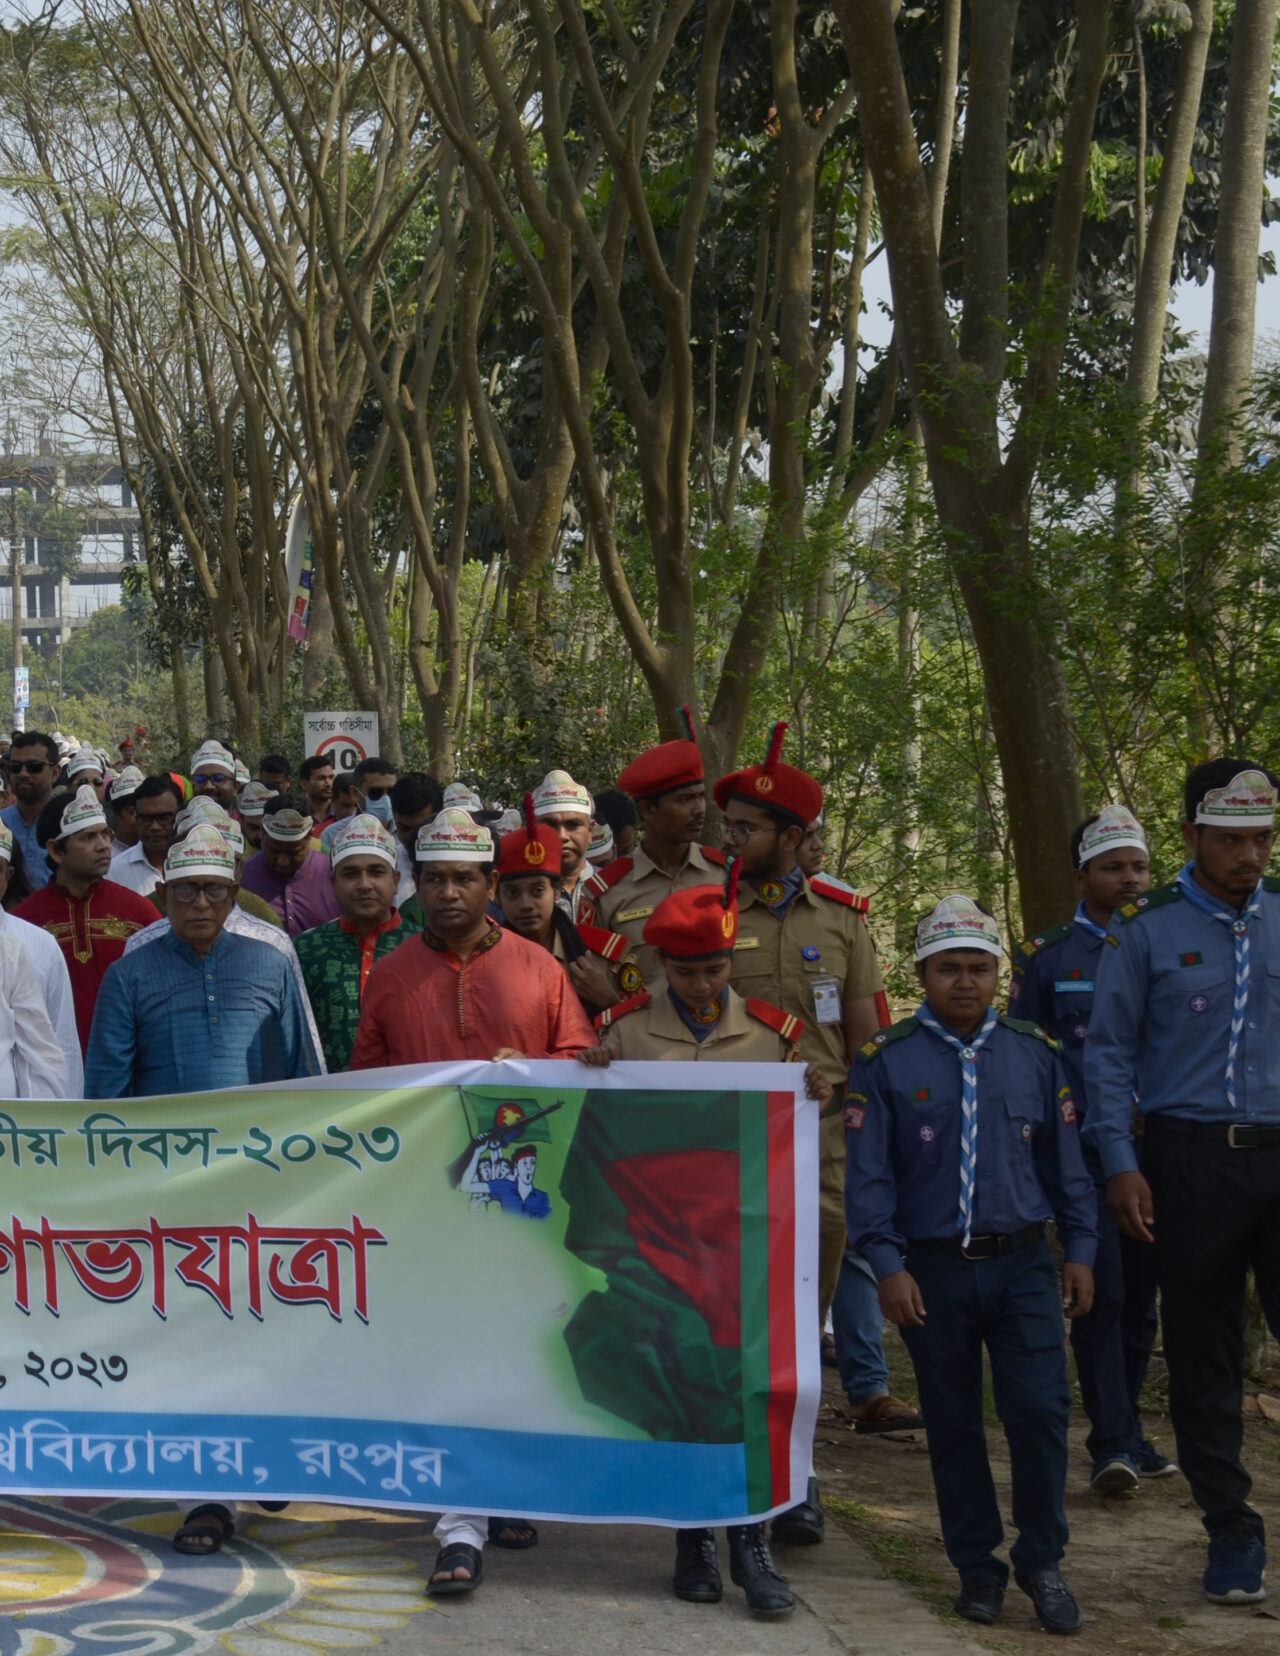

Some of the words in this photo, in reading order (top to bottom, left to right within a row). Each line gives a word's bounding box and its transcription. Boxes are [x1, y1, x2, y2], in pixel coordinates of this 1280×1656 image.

[307, 716, 336, 732] সর্বোচ্চ
[339, 716, 373, 732] গতিসীমা
[328, 748, 358, 771] 10
[77, 1111, 402, 1173] দিবস-২০২৩
[24, 1350, 128, 1388] ২০২৩
[290, 1437, 451, 1497] রংপুর
